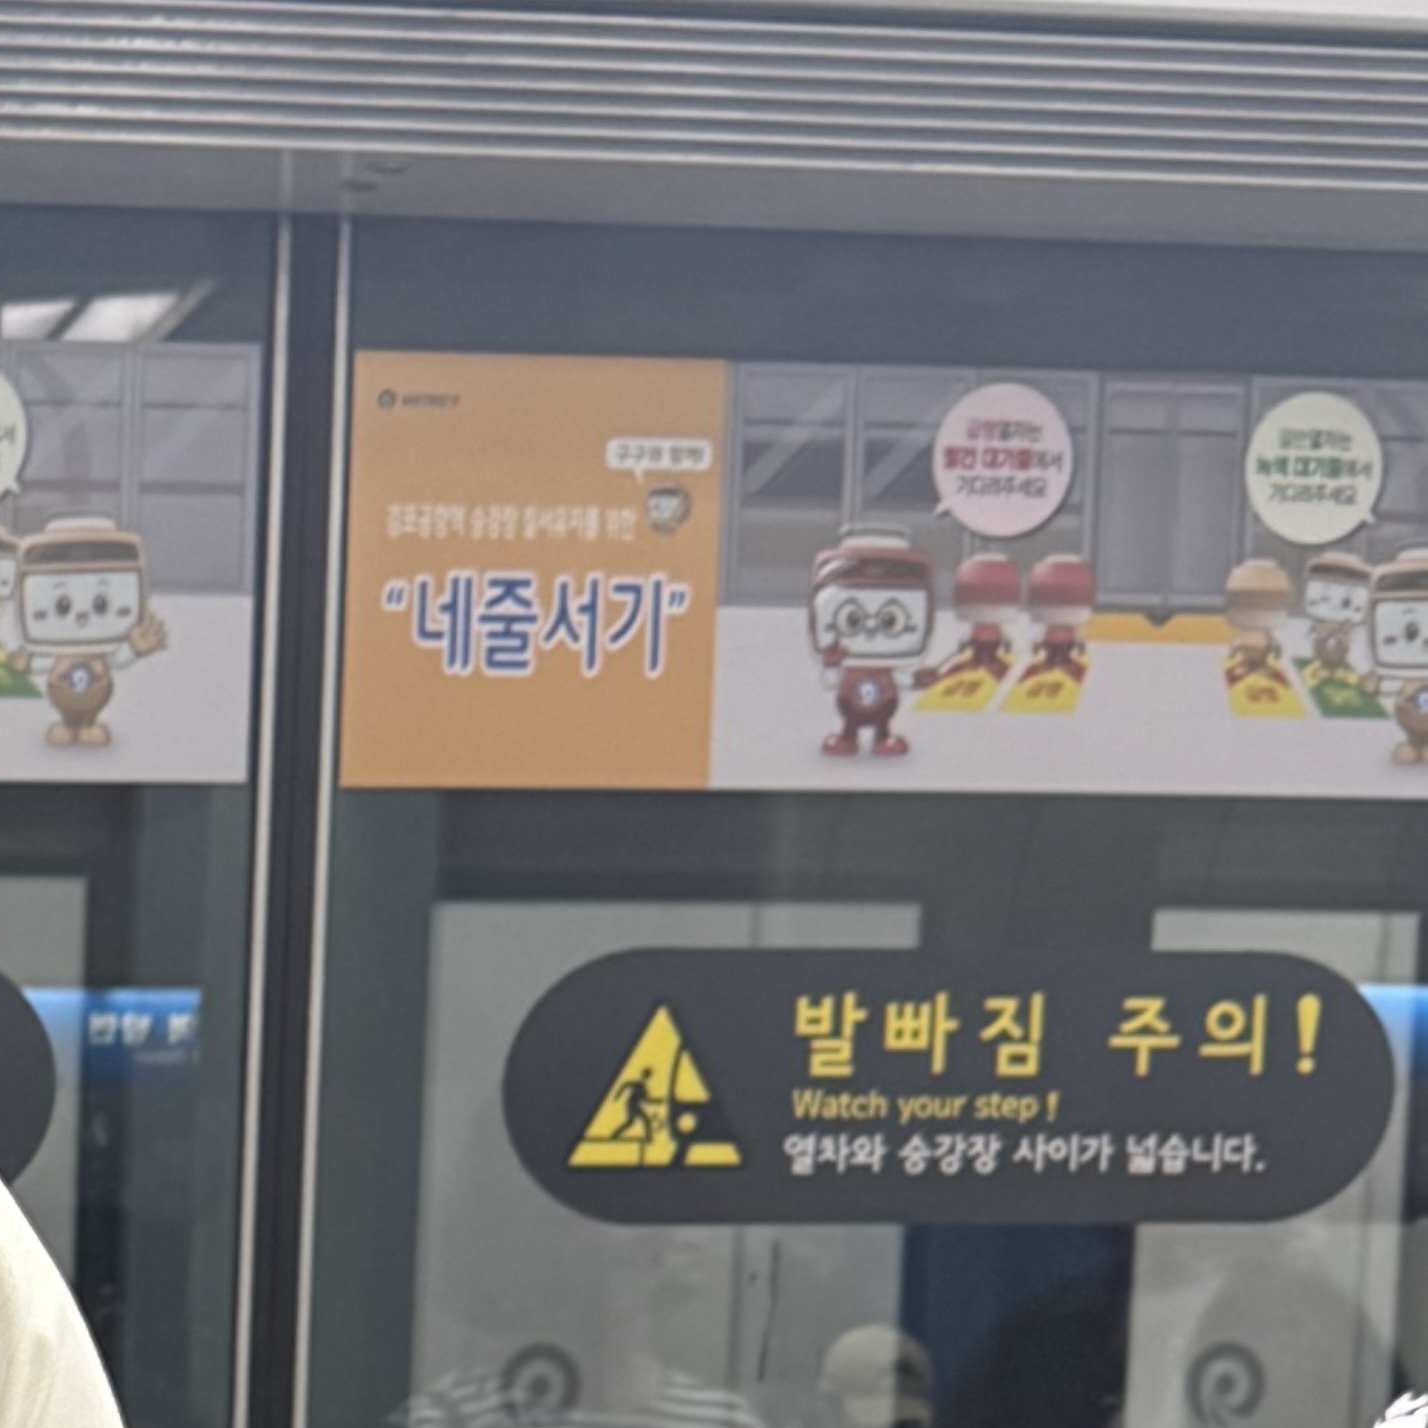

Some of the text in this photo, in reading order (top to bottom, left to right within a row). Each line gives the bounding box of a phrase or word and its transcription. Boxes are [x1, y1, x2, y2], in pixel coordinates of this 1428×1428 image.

[794, 992, 1045, 1077] 발빠짐
[792, 1089, 889, 1120] Watch
[898, 1095, 967, 1125] your
[784, 1133, 1267, 1175] 열차와 승강장 사이가 넓습니다.
